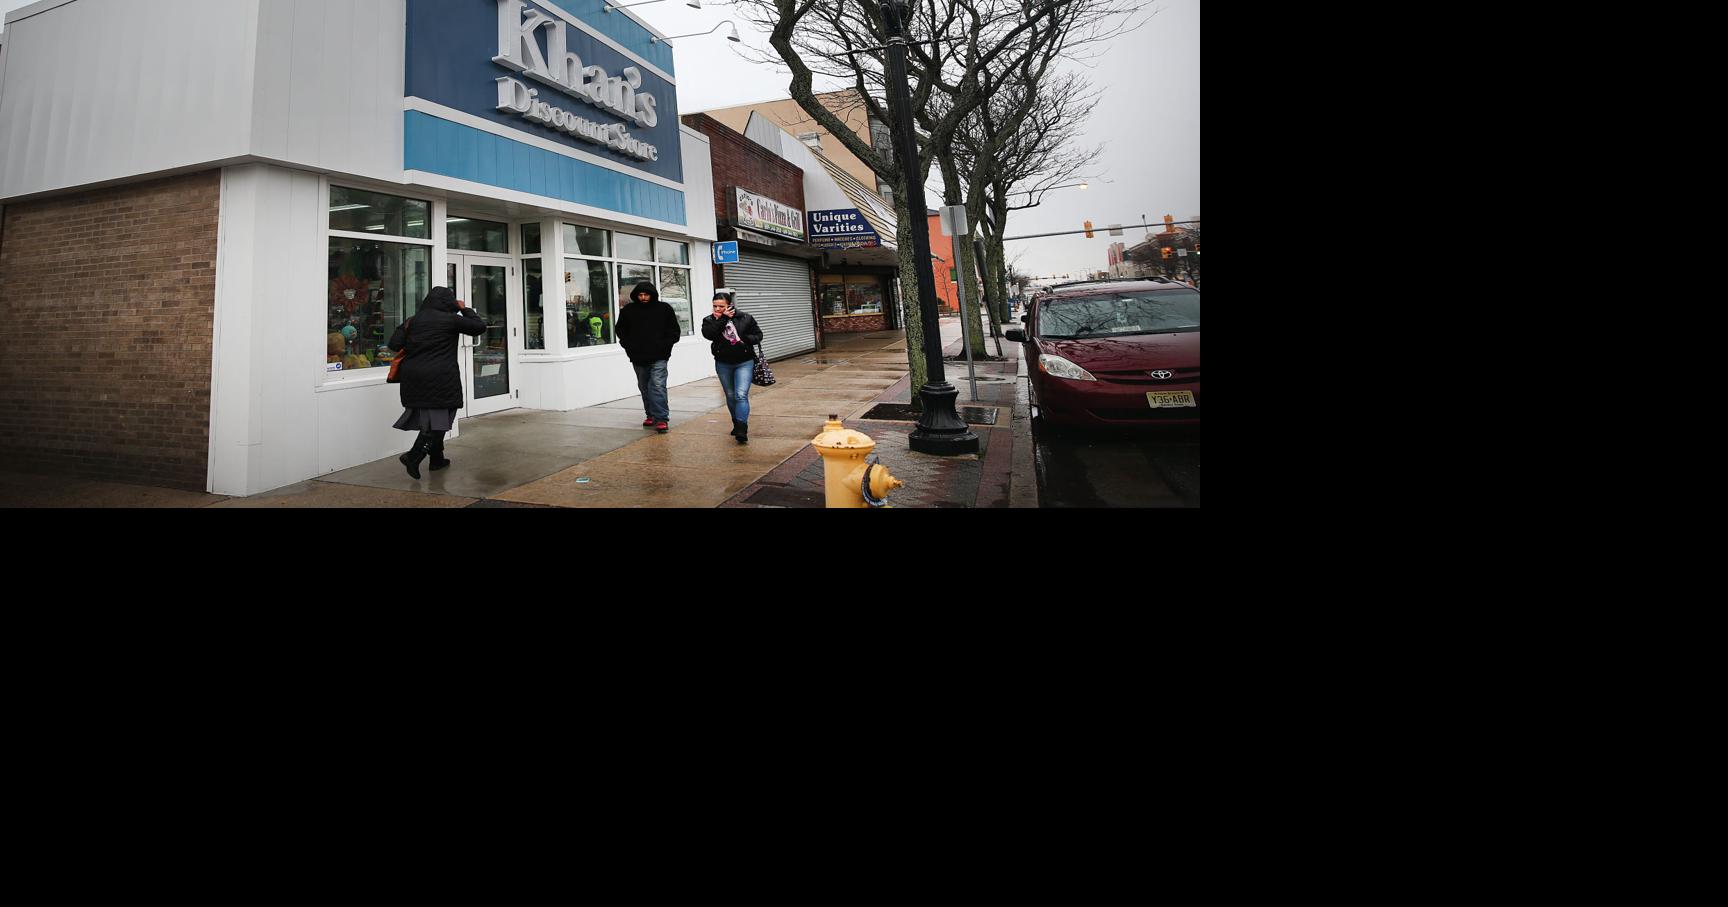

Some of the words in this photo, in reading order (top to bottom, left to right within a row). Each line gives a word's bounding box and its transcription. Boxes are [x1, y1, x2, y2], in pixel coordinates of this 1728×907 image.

[492, 0, 658, 127] Khan's
[495, 76, 610, 146] Discount
[607, 123, 659, 162] Store
[813, 211, 857, 223] Unique
[813, 222, 864, 233] Varities
